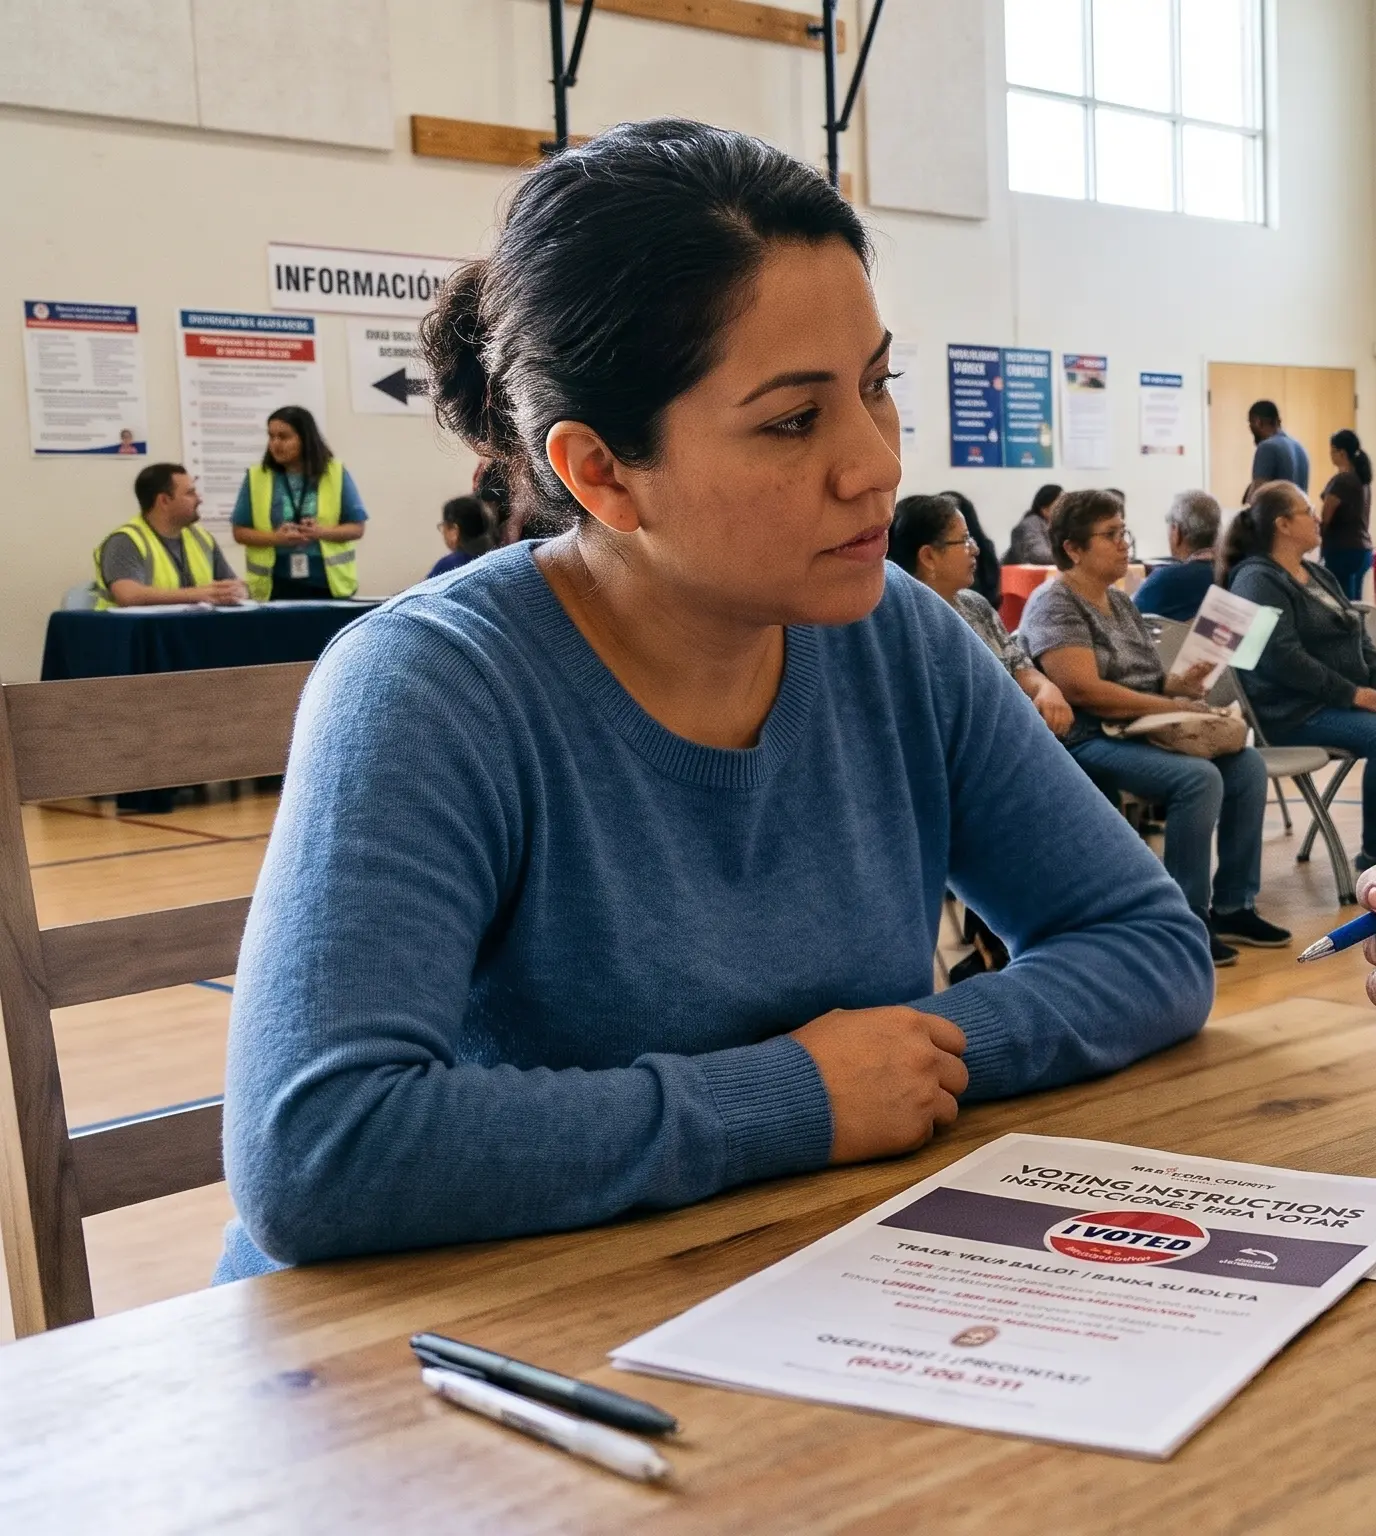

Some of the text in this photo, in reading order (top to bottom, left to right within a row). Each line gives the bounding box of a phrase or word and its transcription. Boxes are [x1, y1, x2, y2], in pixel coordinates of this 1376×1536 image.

[275, 264, 446, 301] INFORMACIÓN
[1000, 1174, 1198, 1211] INSTRUCCIONES
[1266, 1213, 1350, 1228] VOTAR
[1020, 1164, 1365, 1220] VOTING INSTRUCTIONS
[1215, 1178, 1276, 1190] COUNTY
[1061, 1223, 1192, 1251] I VOTED
[1009, 1261, 1080, 1275] BALLOT
[1158, 1282, 1184, 1291] SU
[1186, 1286, 1258, 1302] BOLETA
